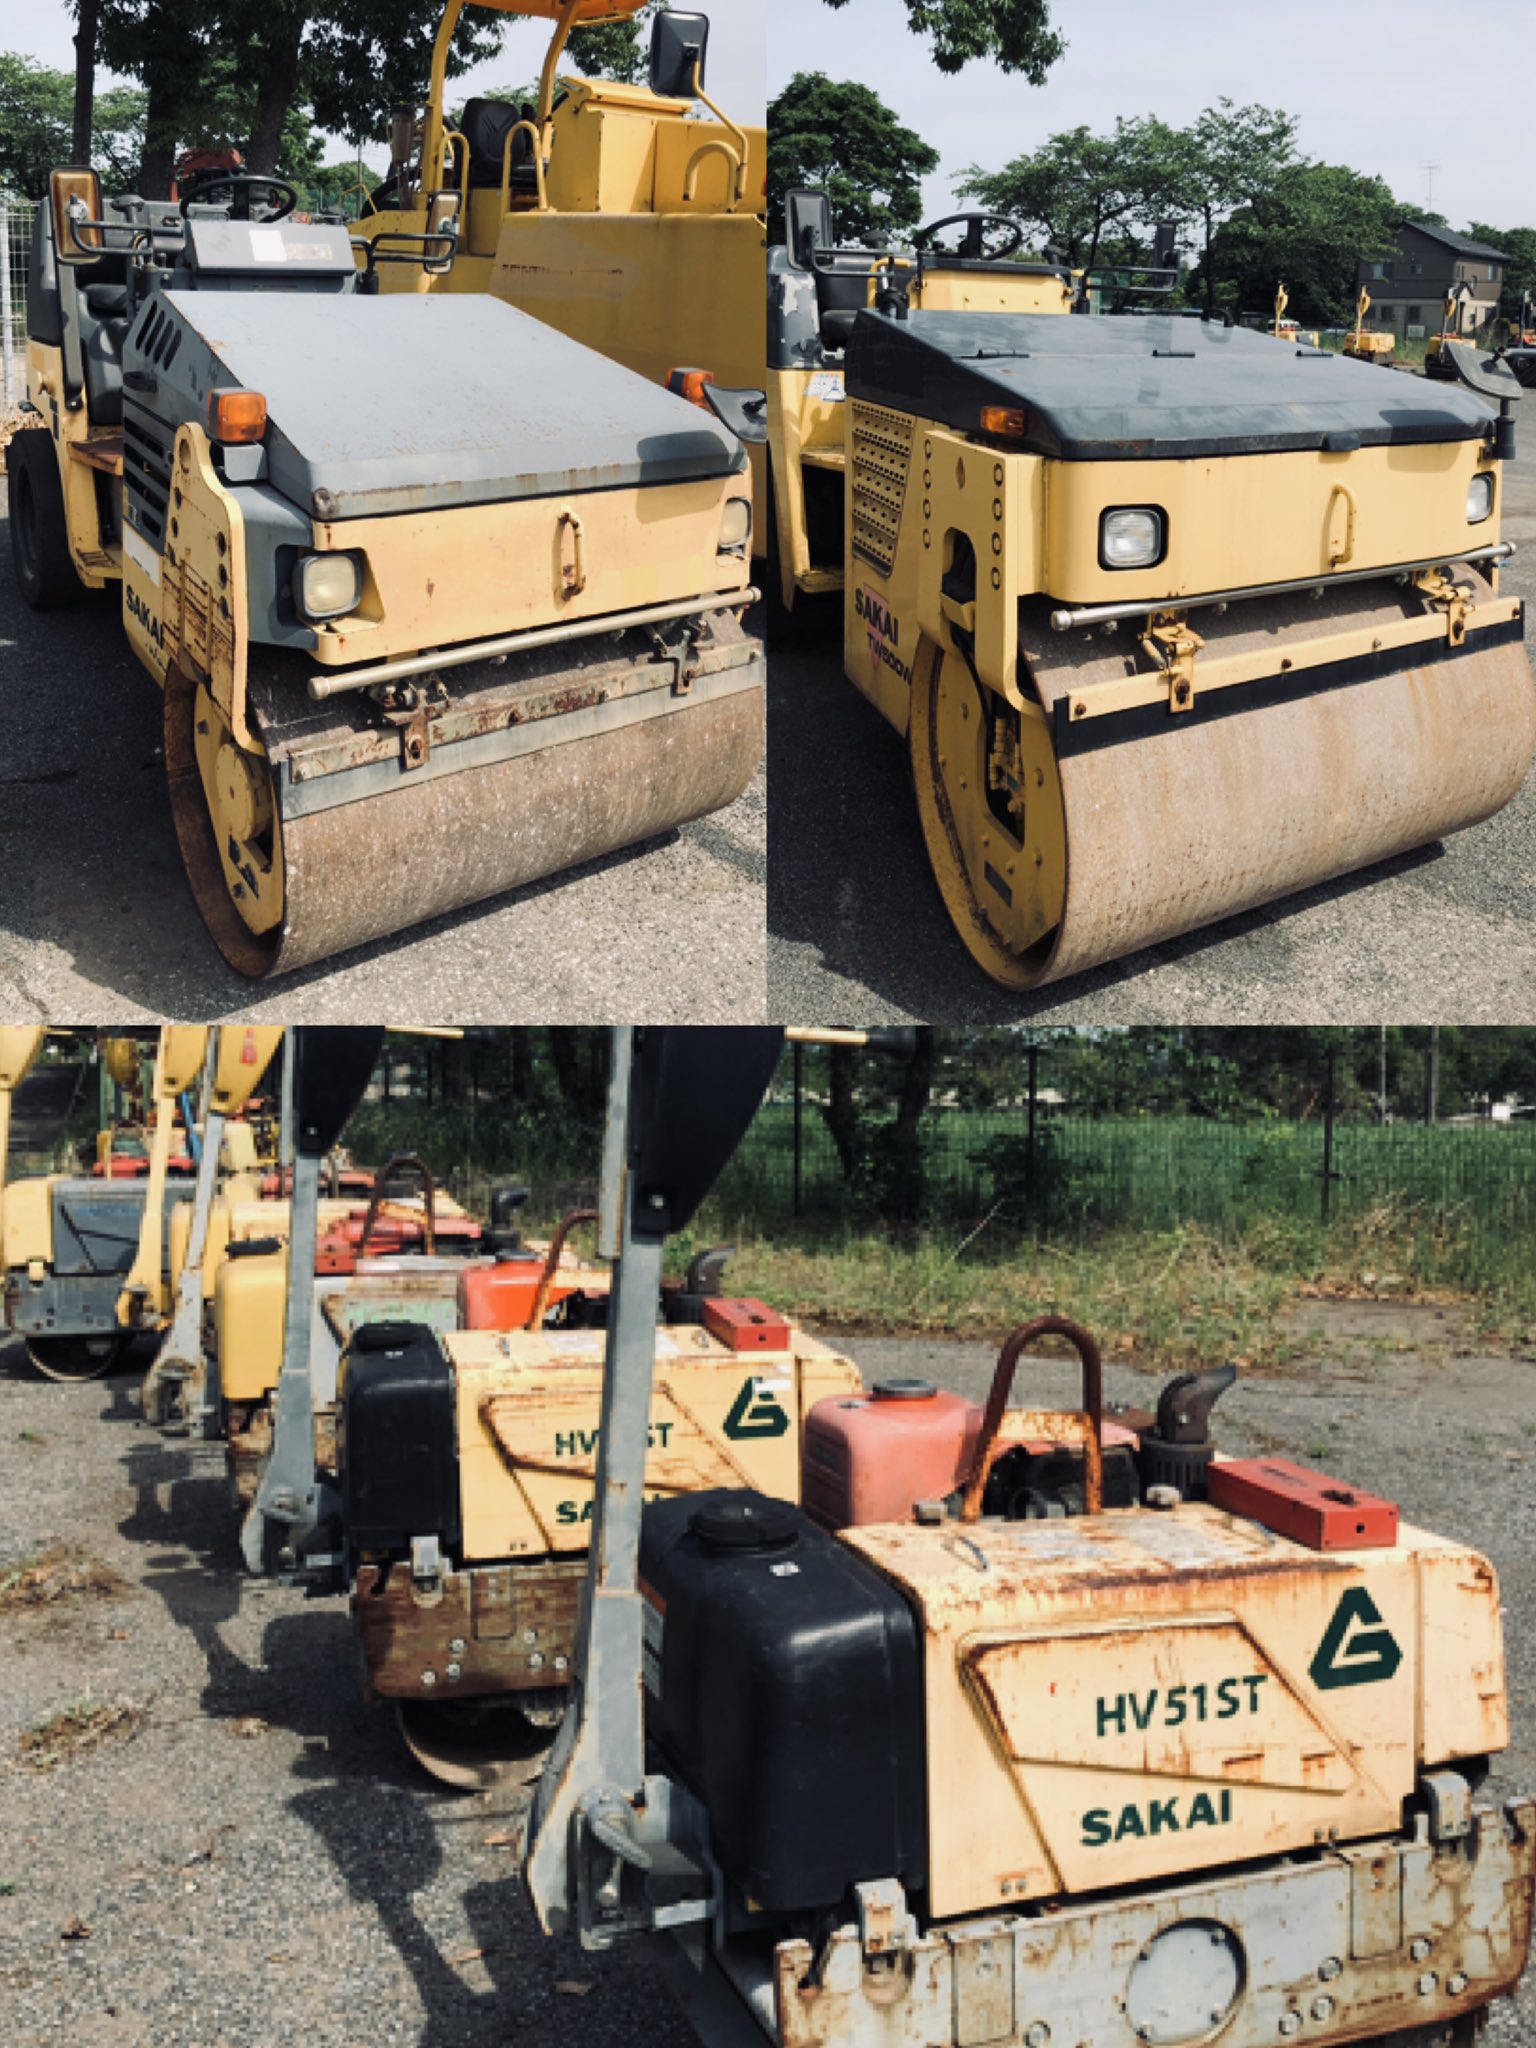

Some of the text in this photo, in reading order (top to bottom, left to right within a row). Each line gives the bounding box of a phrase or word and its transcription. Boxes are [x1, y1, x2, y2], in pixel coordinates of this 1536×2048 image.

[126, 584, 164, 649] SAKAI
[855, 588, 899, 646] SAKAI
[1096, 1674, 1268, 1736] HV51ST
[1079, 1789, 1232, 1847] SAKAI
